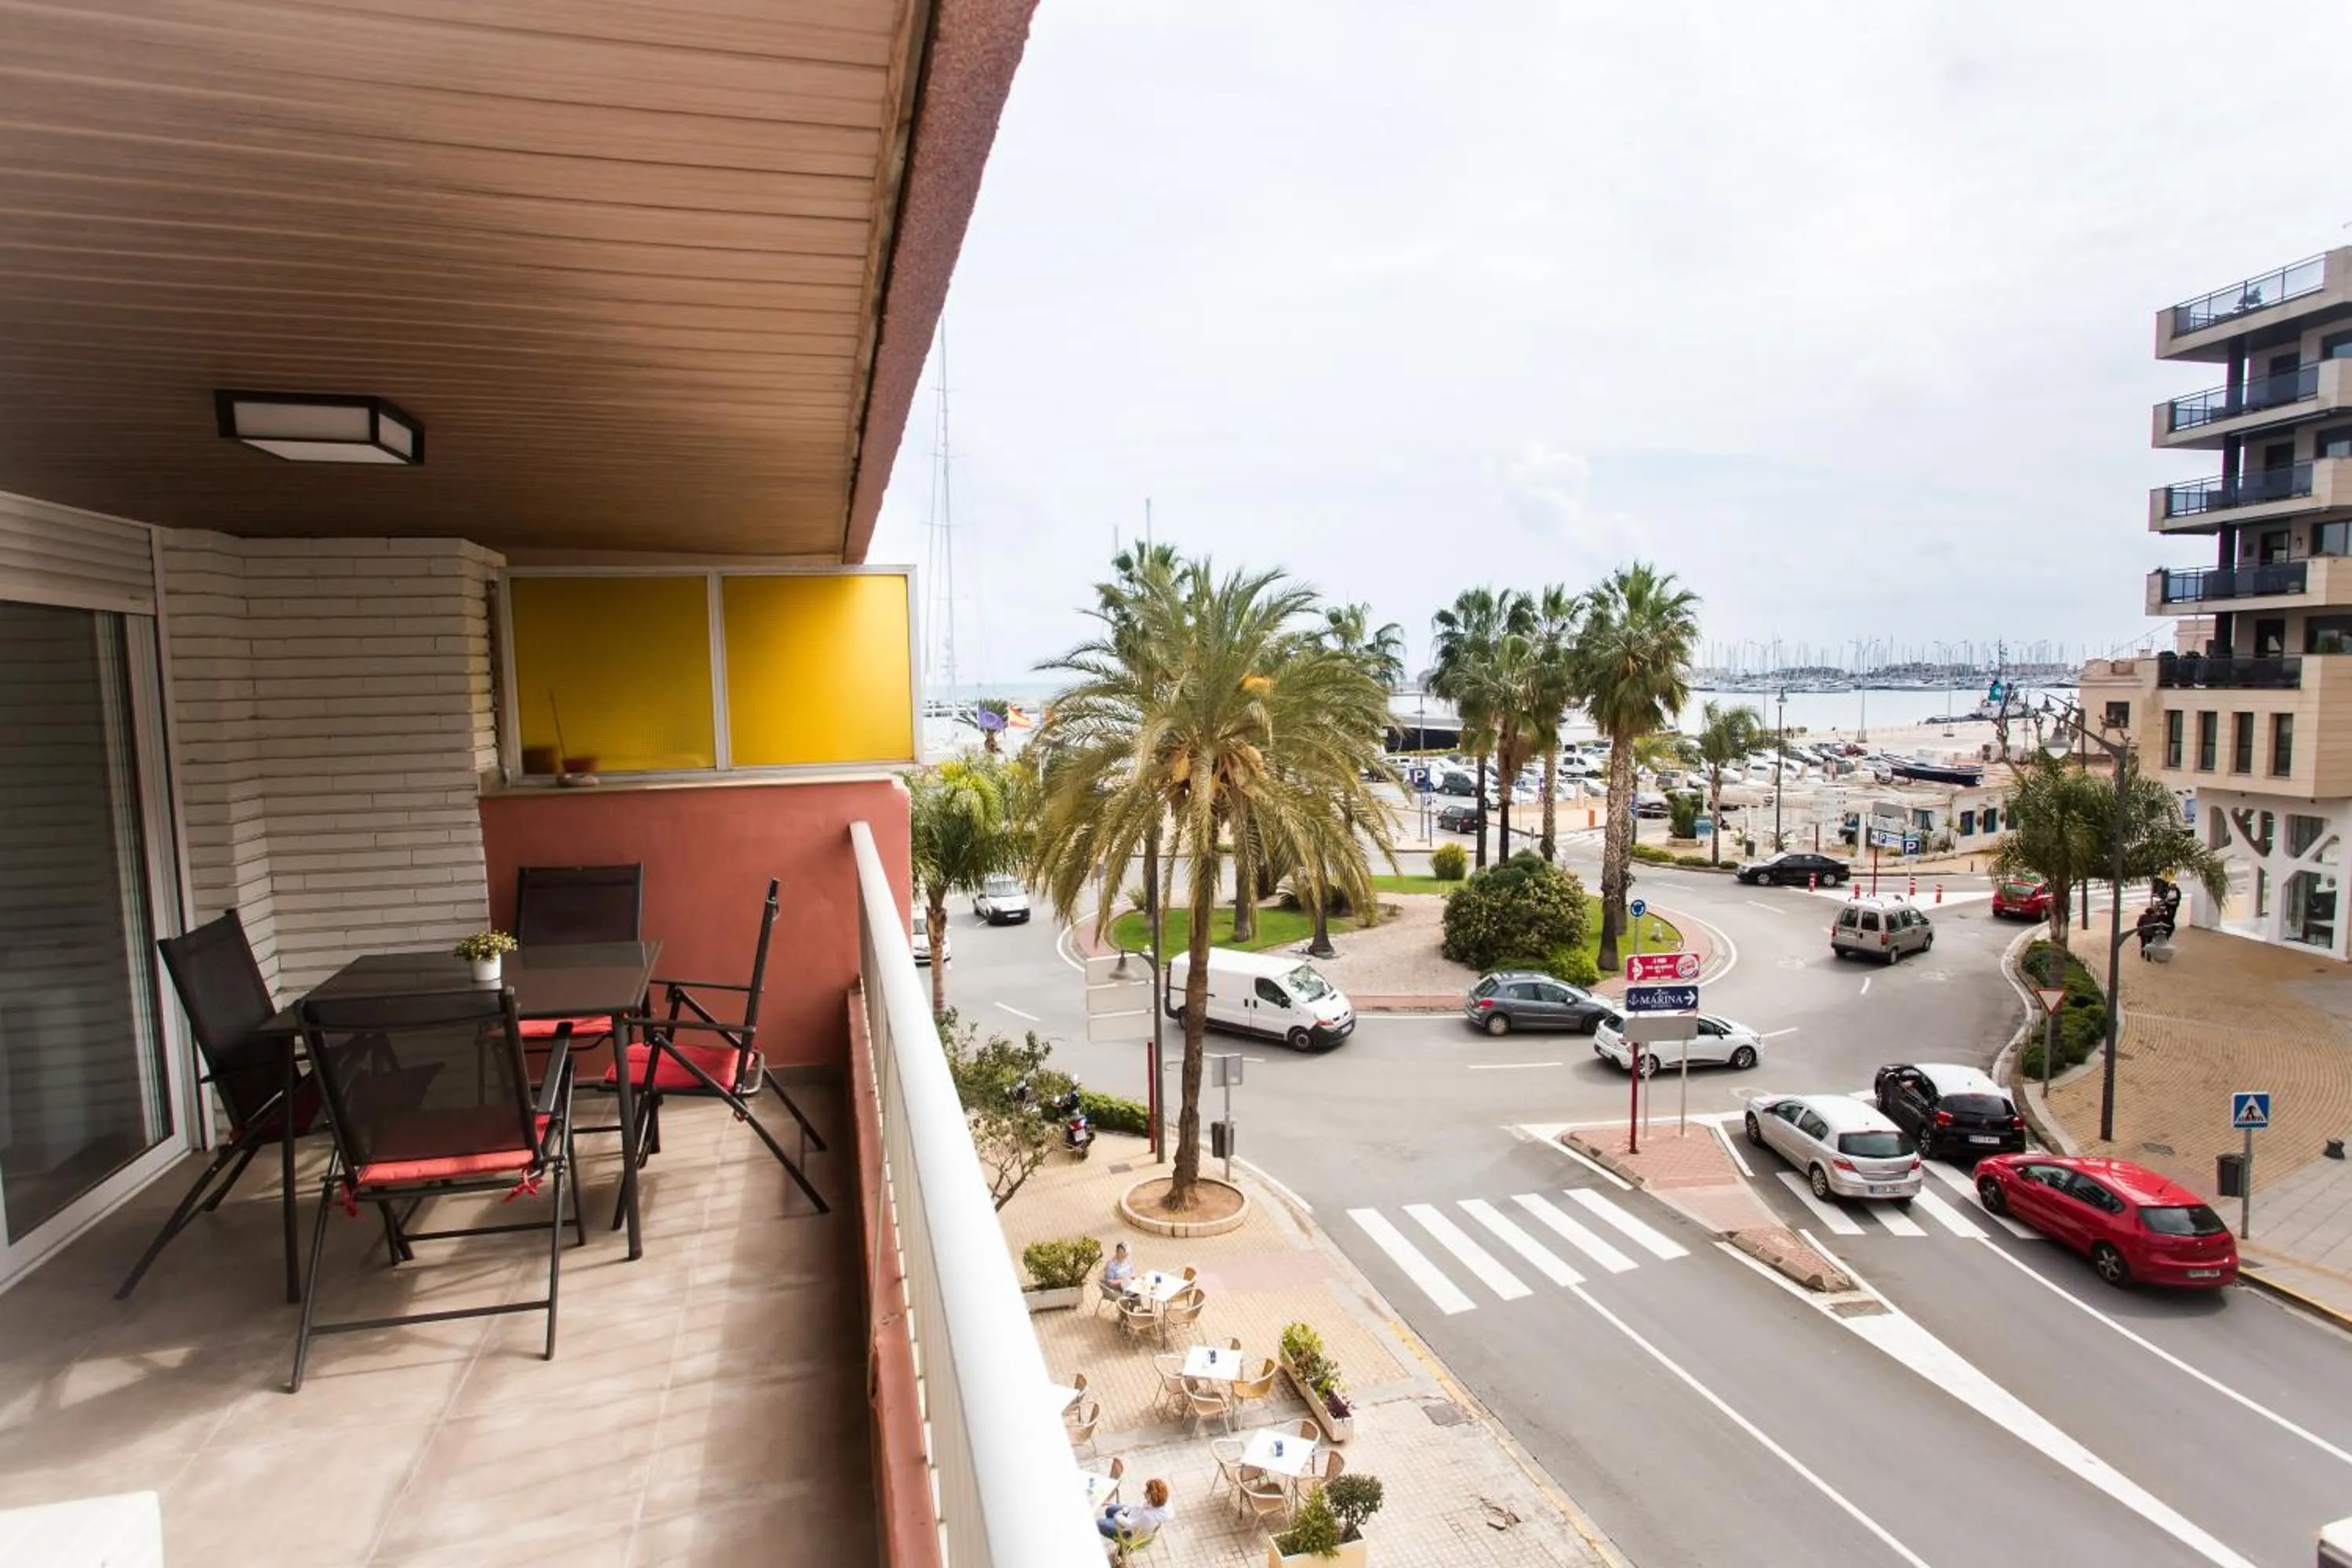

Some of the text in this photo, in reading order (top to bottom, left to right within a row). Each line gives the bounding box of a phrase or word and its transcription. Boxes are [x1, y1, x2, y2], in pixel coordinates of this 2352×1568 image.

[1414, 770, 1425, 782] P
[1906, 841, 1917, 853] P
[1639, 995, 1683, 1004] MARINA
